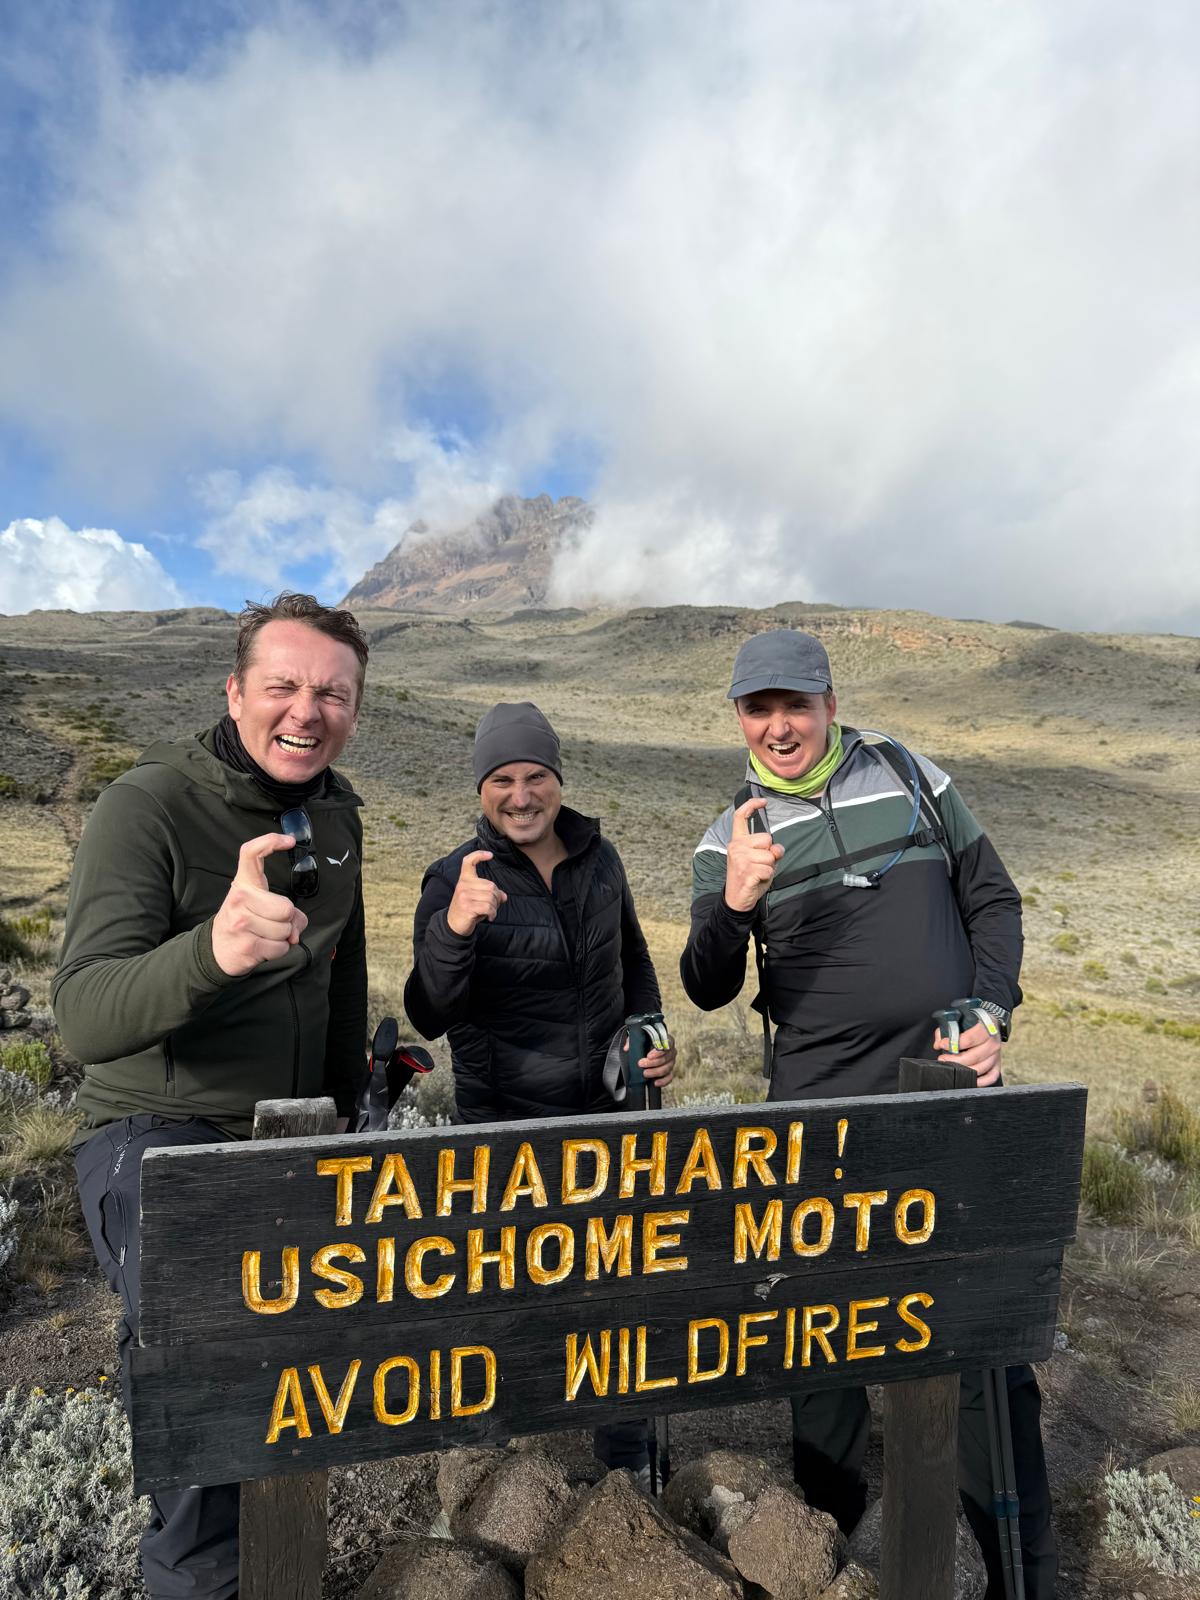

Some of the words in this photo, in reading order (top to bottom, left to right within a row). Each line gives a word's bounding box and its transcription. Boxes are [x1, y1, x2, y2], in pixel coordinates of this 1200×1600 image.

[316, 1121, 803, 1227] TAHADHARI
[241, 1210, 691, 1315] USICHOME
[734, 1188, 936, 1262] MOTO
[265, 1346, 497, 1444] AVOID
[565, 1292, 934, 1401] WILDFIRES
